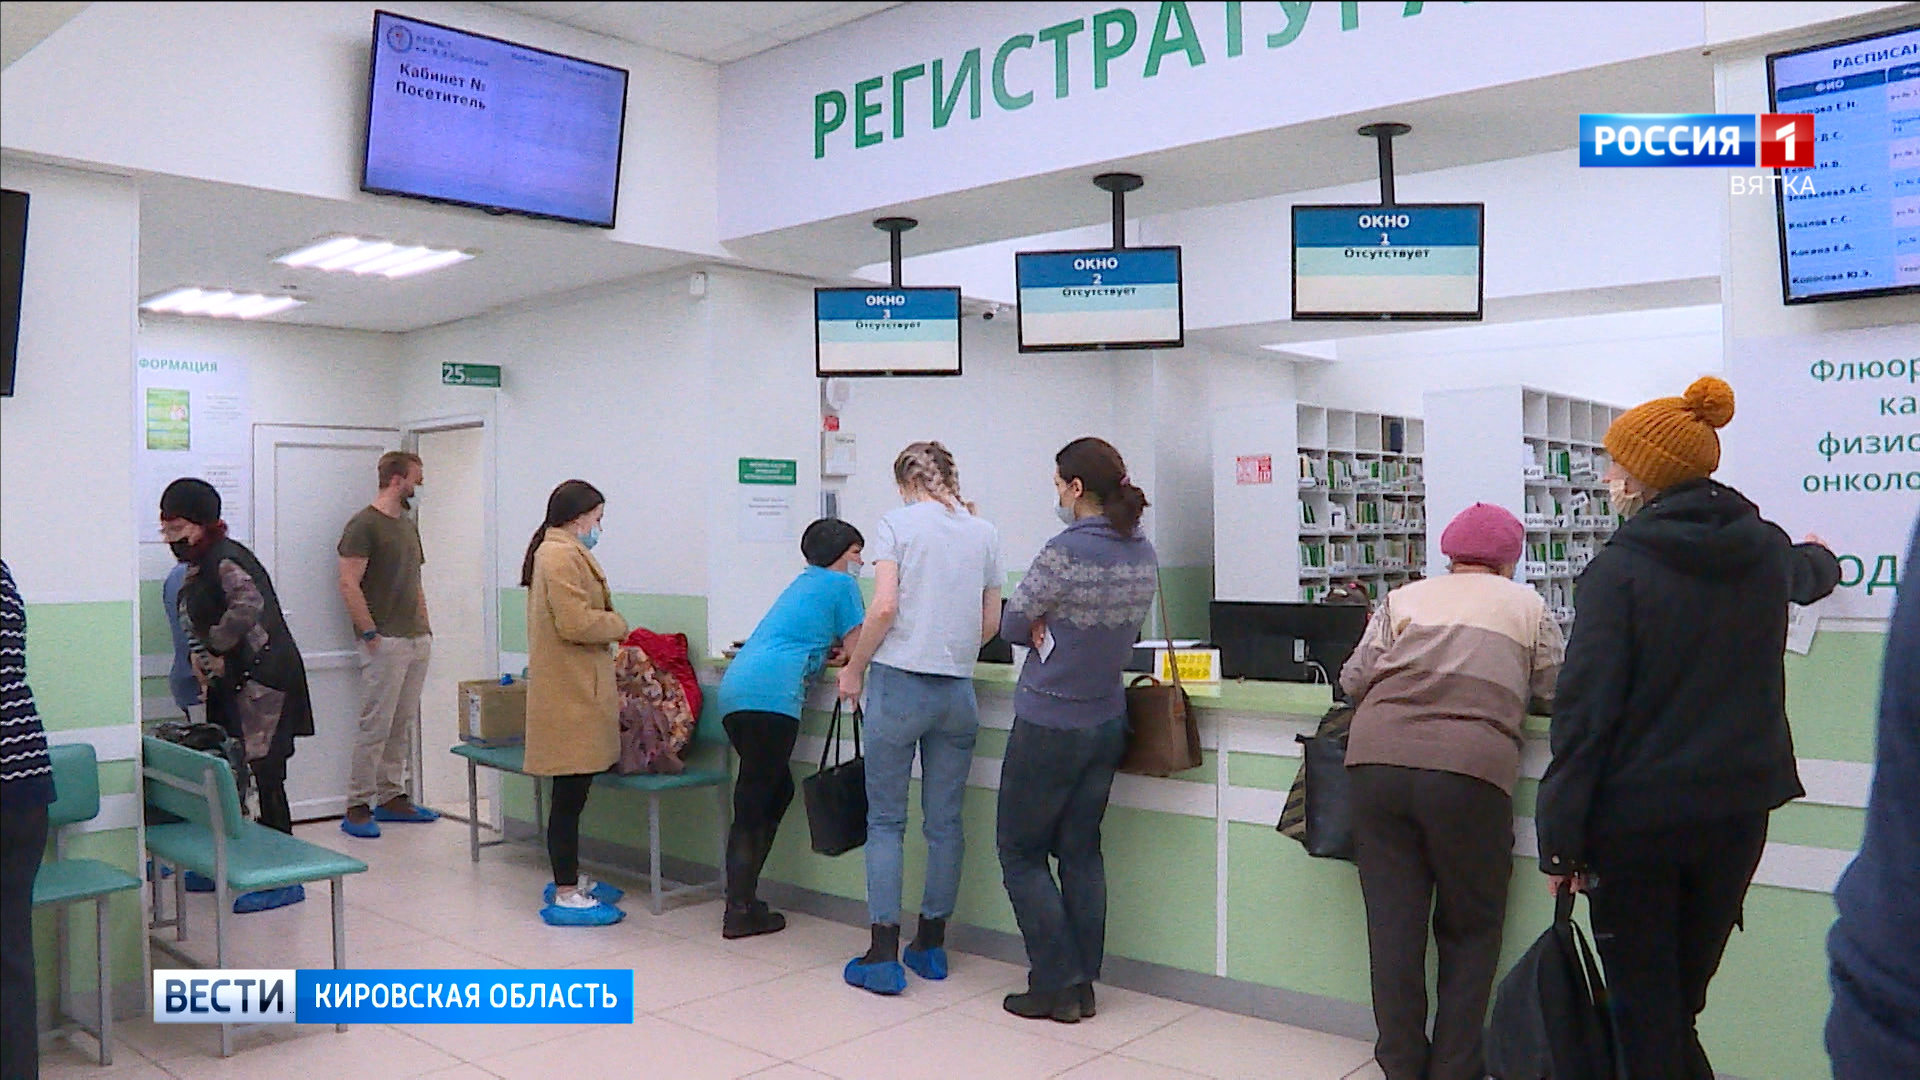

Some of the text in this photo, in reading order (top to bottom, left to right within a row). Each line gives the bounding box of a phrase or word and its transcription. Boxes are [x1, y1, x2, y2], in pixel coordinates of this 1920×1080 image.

[400, 63, 466, 88] Кабинет
[814, 1, 1474, 160] РЕГИСТРАТУ
[396, 80, 486, 110] Посетитель
[1358, 214, 1410, 228] ОКНО
[1379, 232, 1391, 246] 1
[1344, 249, 1430, 260] Отсутствует
[1073, 257, 1119, 271] ОКНО
[1092, 273, 1103, 285] 2
[1062, 287, 1136, 298] Отсутствует
[866, 295, 906, 306] ОКНО
[138, 358, 218, 374] ФОРМАЦИЯ
[443, 365, 466, 383] 25
